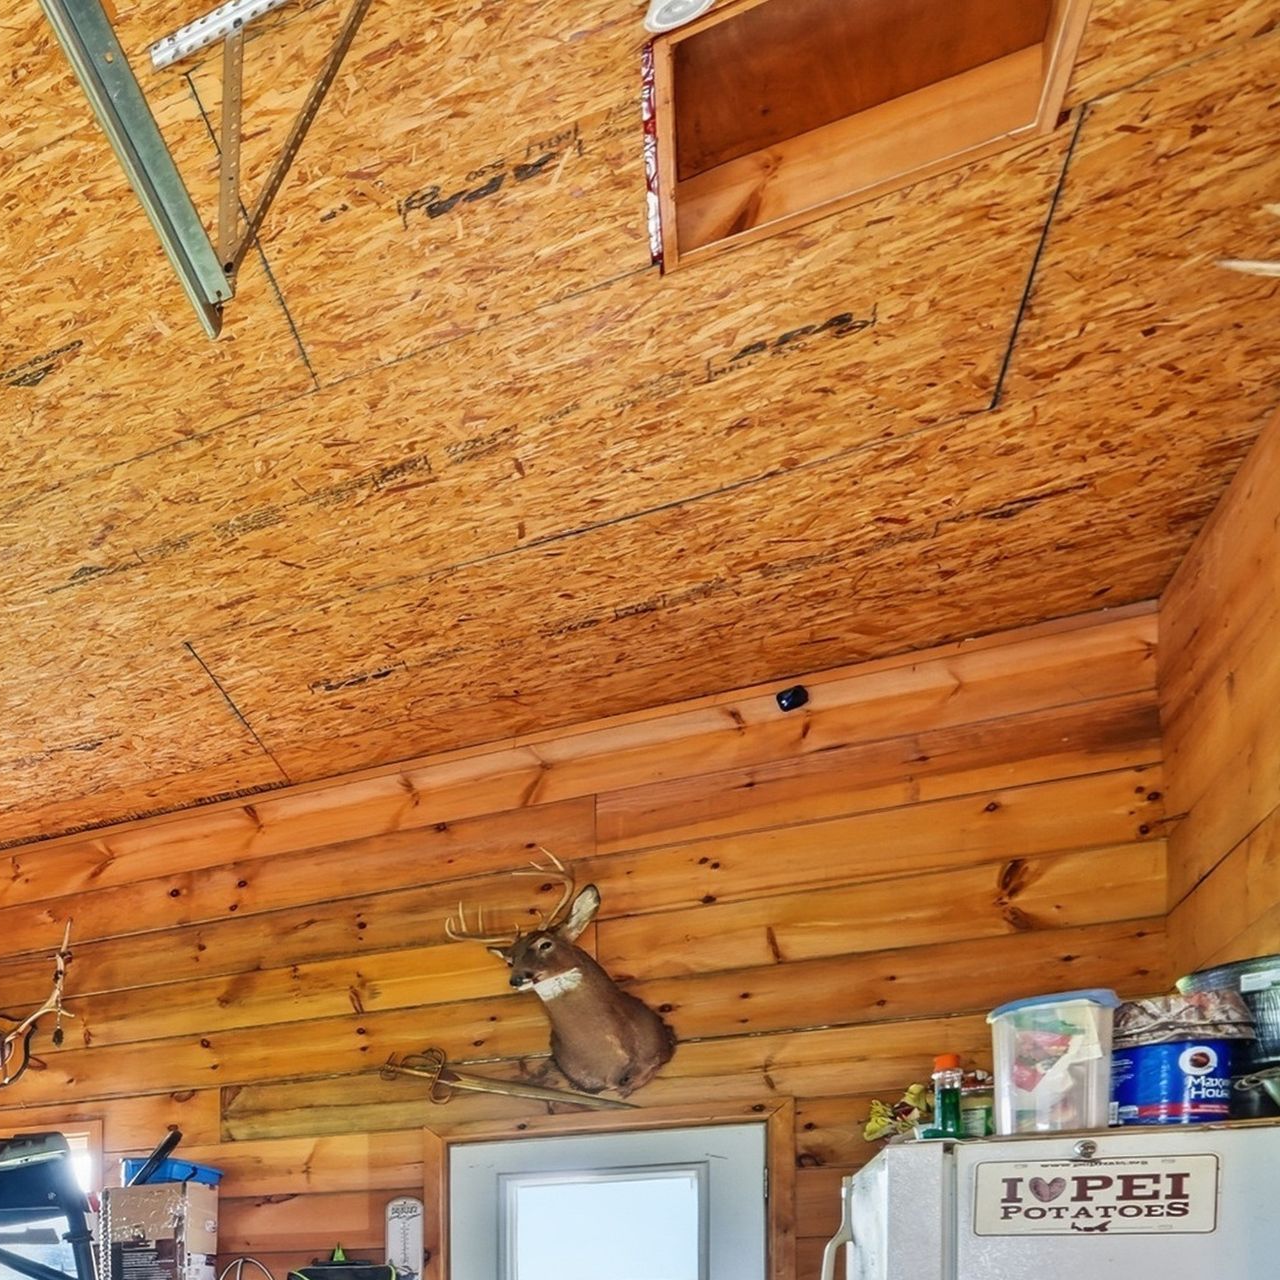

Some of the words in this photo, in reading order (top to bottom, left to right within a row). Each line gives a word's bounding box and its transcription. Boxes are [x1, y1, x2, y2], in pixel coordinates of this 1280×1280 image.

[1001, 1177, 1024, 1203] I
[1071, 1173, 1190, 1202] PEI
[1000, 1202, 1190, 1220] POTATOES
